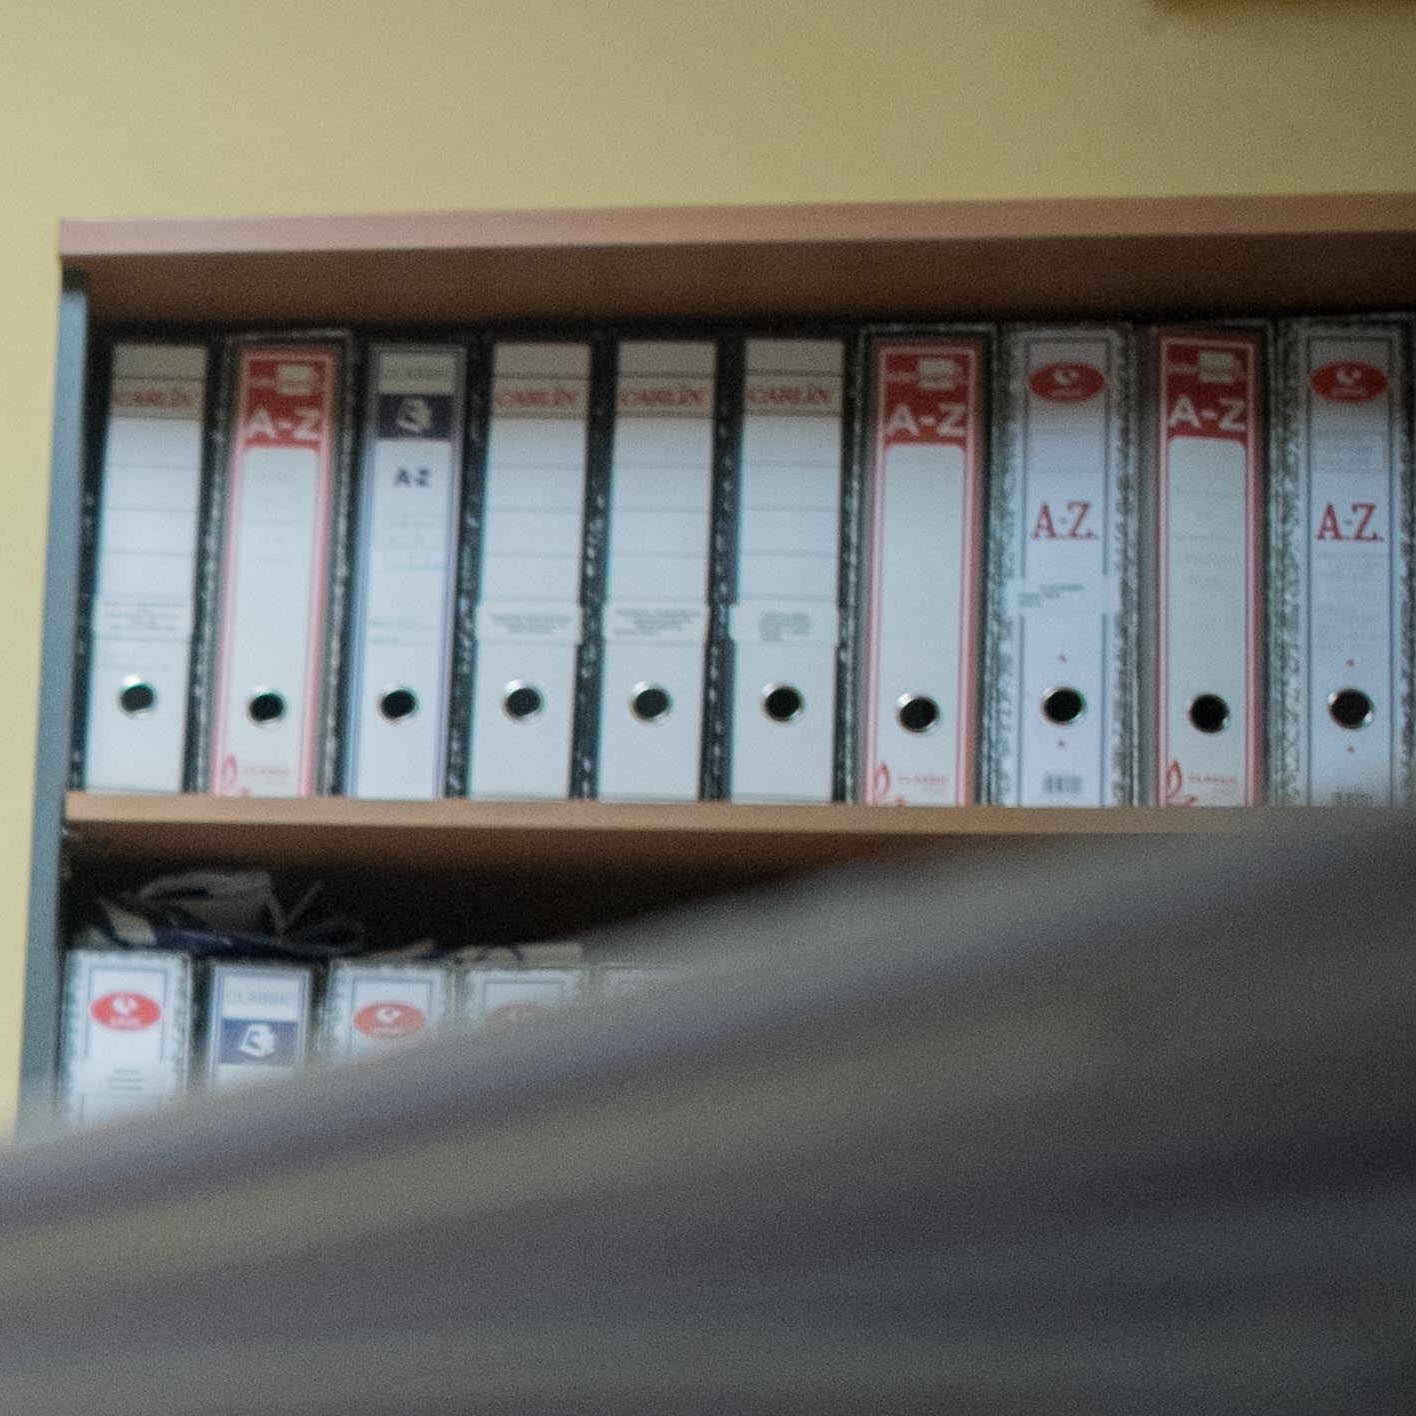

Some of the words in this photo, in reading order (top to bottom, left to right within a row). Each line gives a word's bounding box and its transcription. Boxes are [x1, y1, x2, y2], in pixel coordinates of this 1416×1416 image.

[246, 406, 323, 438] A-Z
[886, 403, 967, 436] A-Z
[1168, 394, 1246, 432] A-Z
